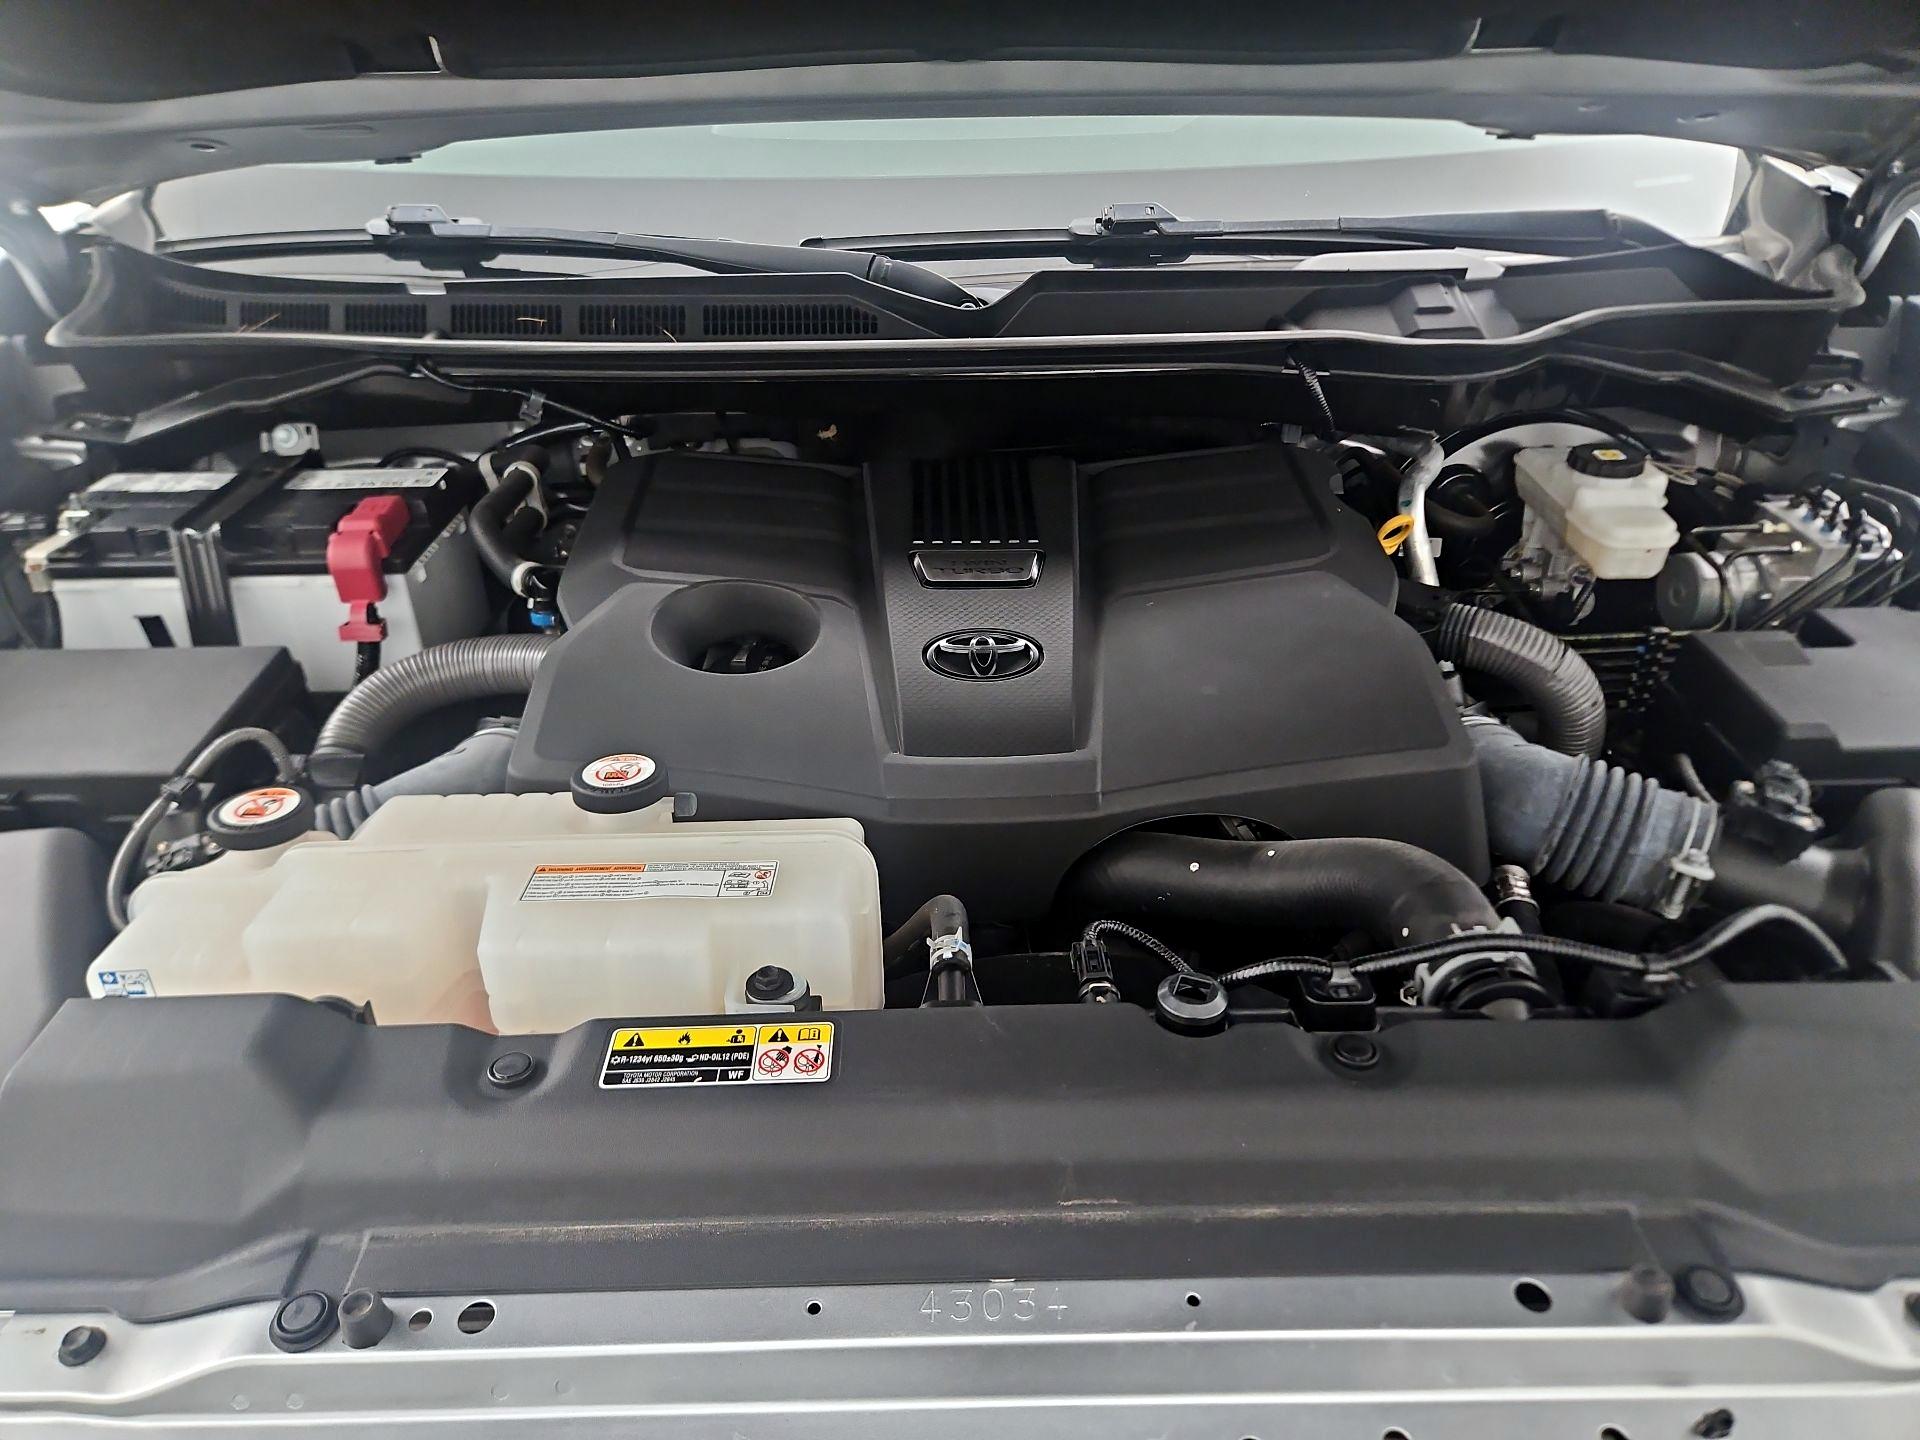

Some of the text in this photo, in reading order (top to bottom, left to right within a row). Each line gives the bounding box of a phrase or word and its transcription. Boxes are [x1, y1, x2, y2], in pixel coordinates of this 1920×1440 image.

[620, 1054, 653, 1064] R-1234yf
[731, 1051, 750, 1061] (POE)
[728, 1070, 745, 1080] WF
[919, 1287, 1069, 1323] 43034
